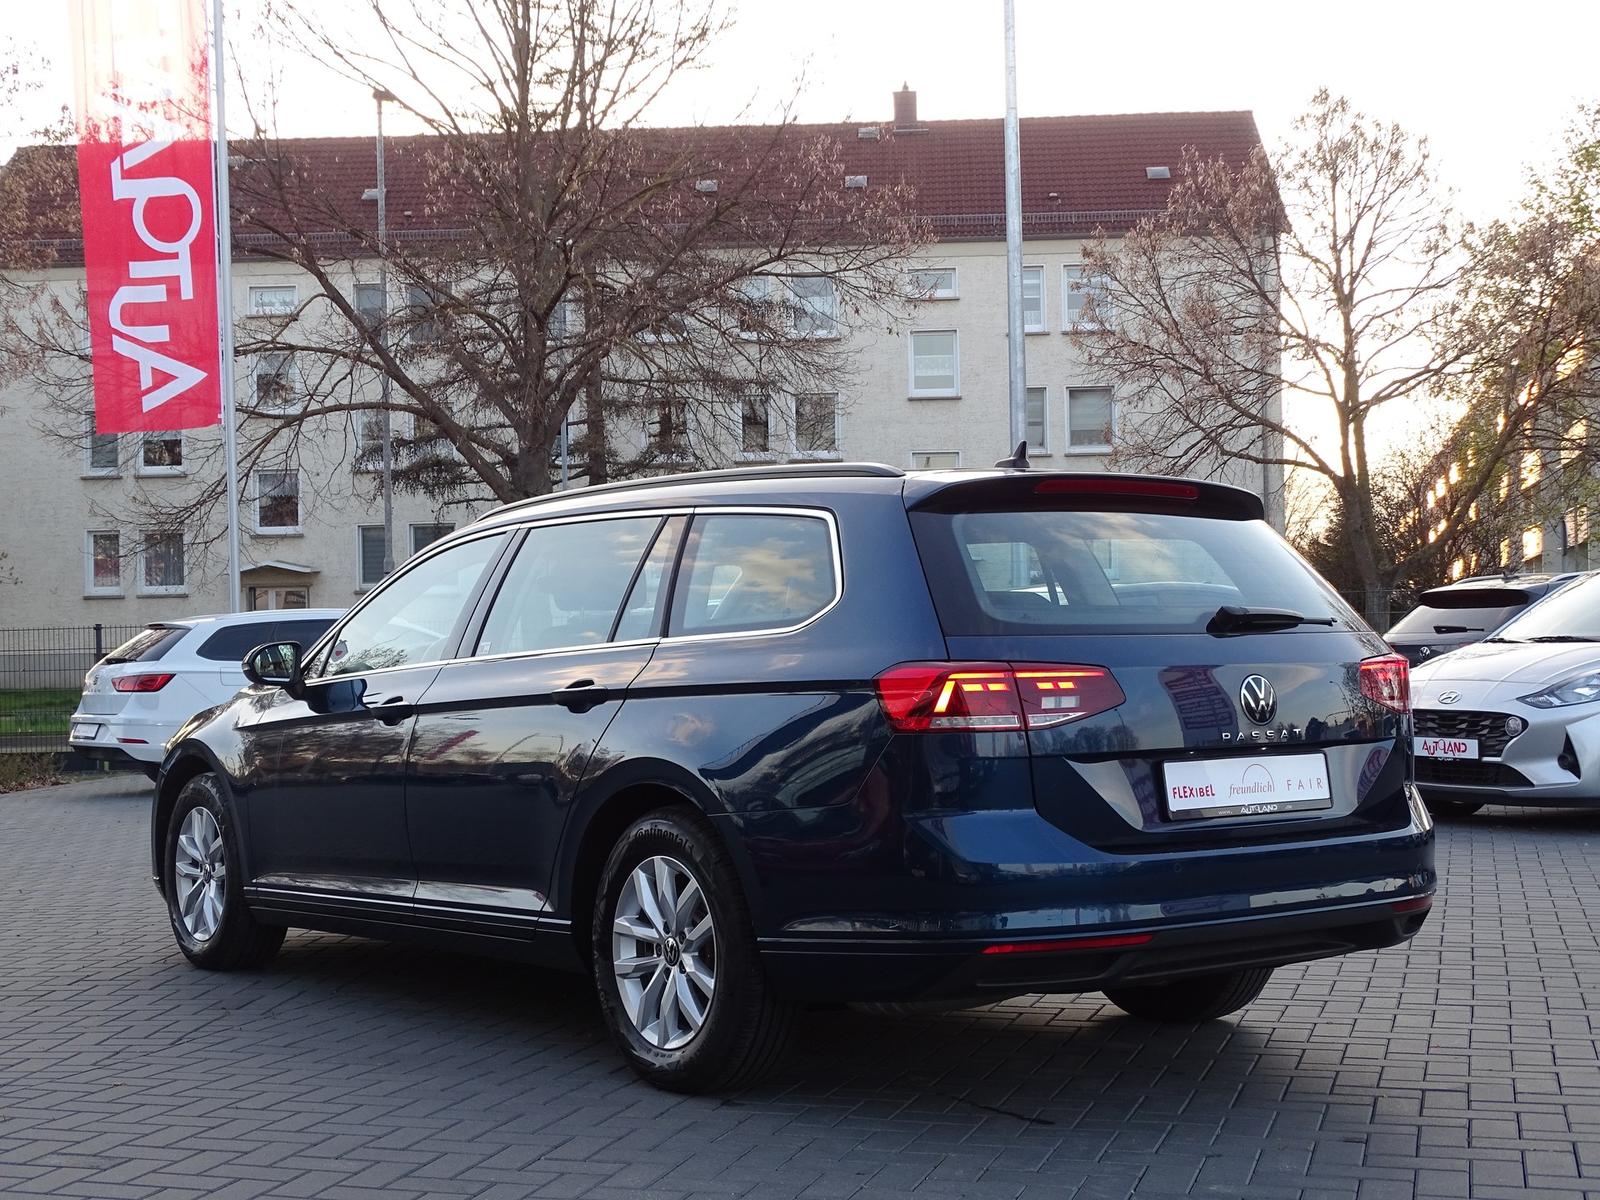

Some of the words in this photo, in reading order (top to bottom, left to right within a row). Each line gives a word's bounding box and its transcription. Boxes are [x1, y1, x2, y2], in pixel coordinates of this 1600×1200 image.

[1222, 728, 1301, 742] PASSAT
[1422, 738, 1467, 756] AUTOLAND
[1172, 783, 1216, 799] FLEXIBEL
[1228, 781, 1273, 798] freundlich
[1286, 777, 1323, 791] FAIR
[635, 824, 688, 849] Continental
